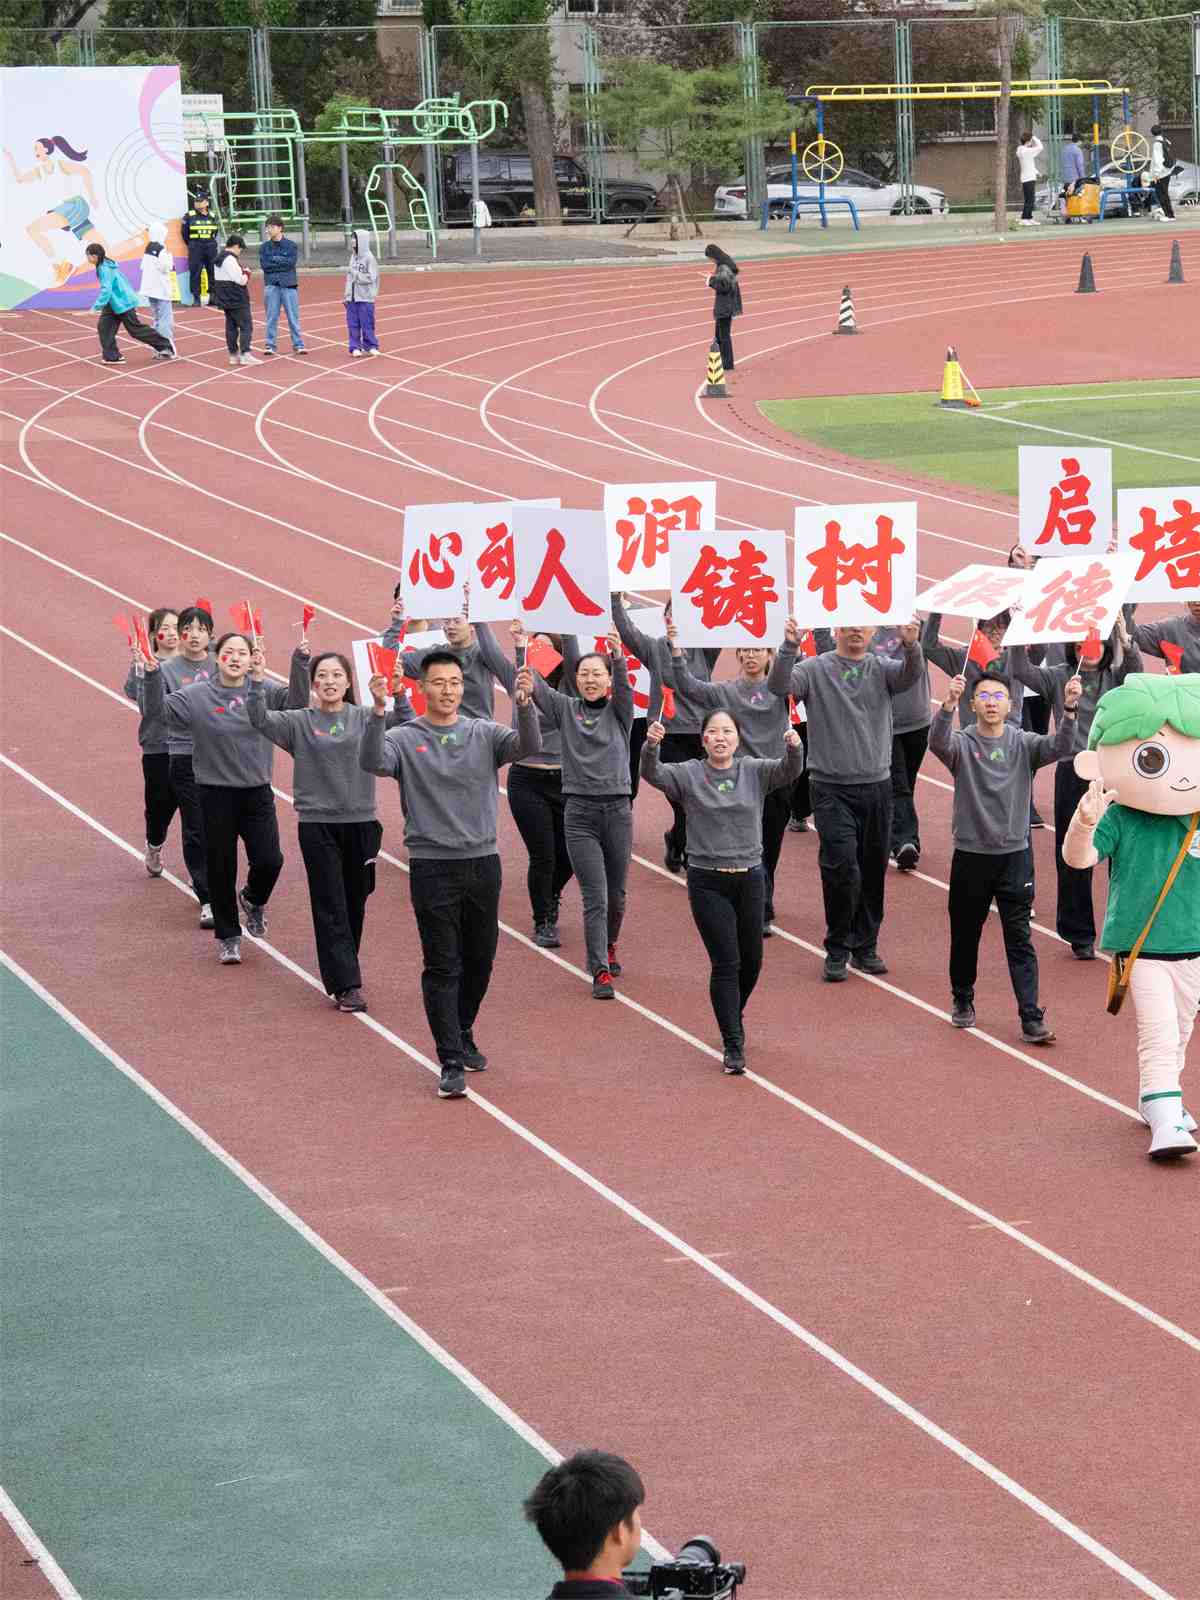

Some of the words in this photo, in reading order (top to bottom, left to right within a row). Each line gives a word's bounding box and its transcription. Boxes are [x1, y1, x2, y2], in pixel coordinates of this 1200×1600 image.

[615, 496, 703, 575] 润
[1035, 457, 1096, 545] 启
[408, 531, 463, 590] 心
[521, 527, 605, 617] 人
[681, 539, 780, 639] 铸
[805, 515, 905, 614] 树
[1025, 562, 1113, 634] 德
